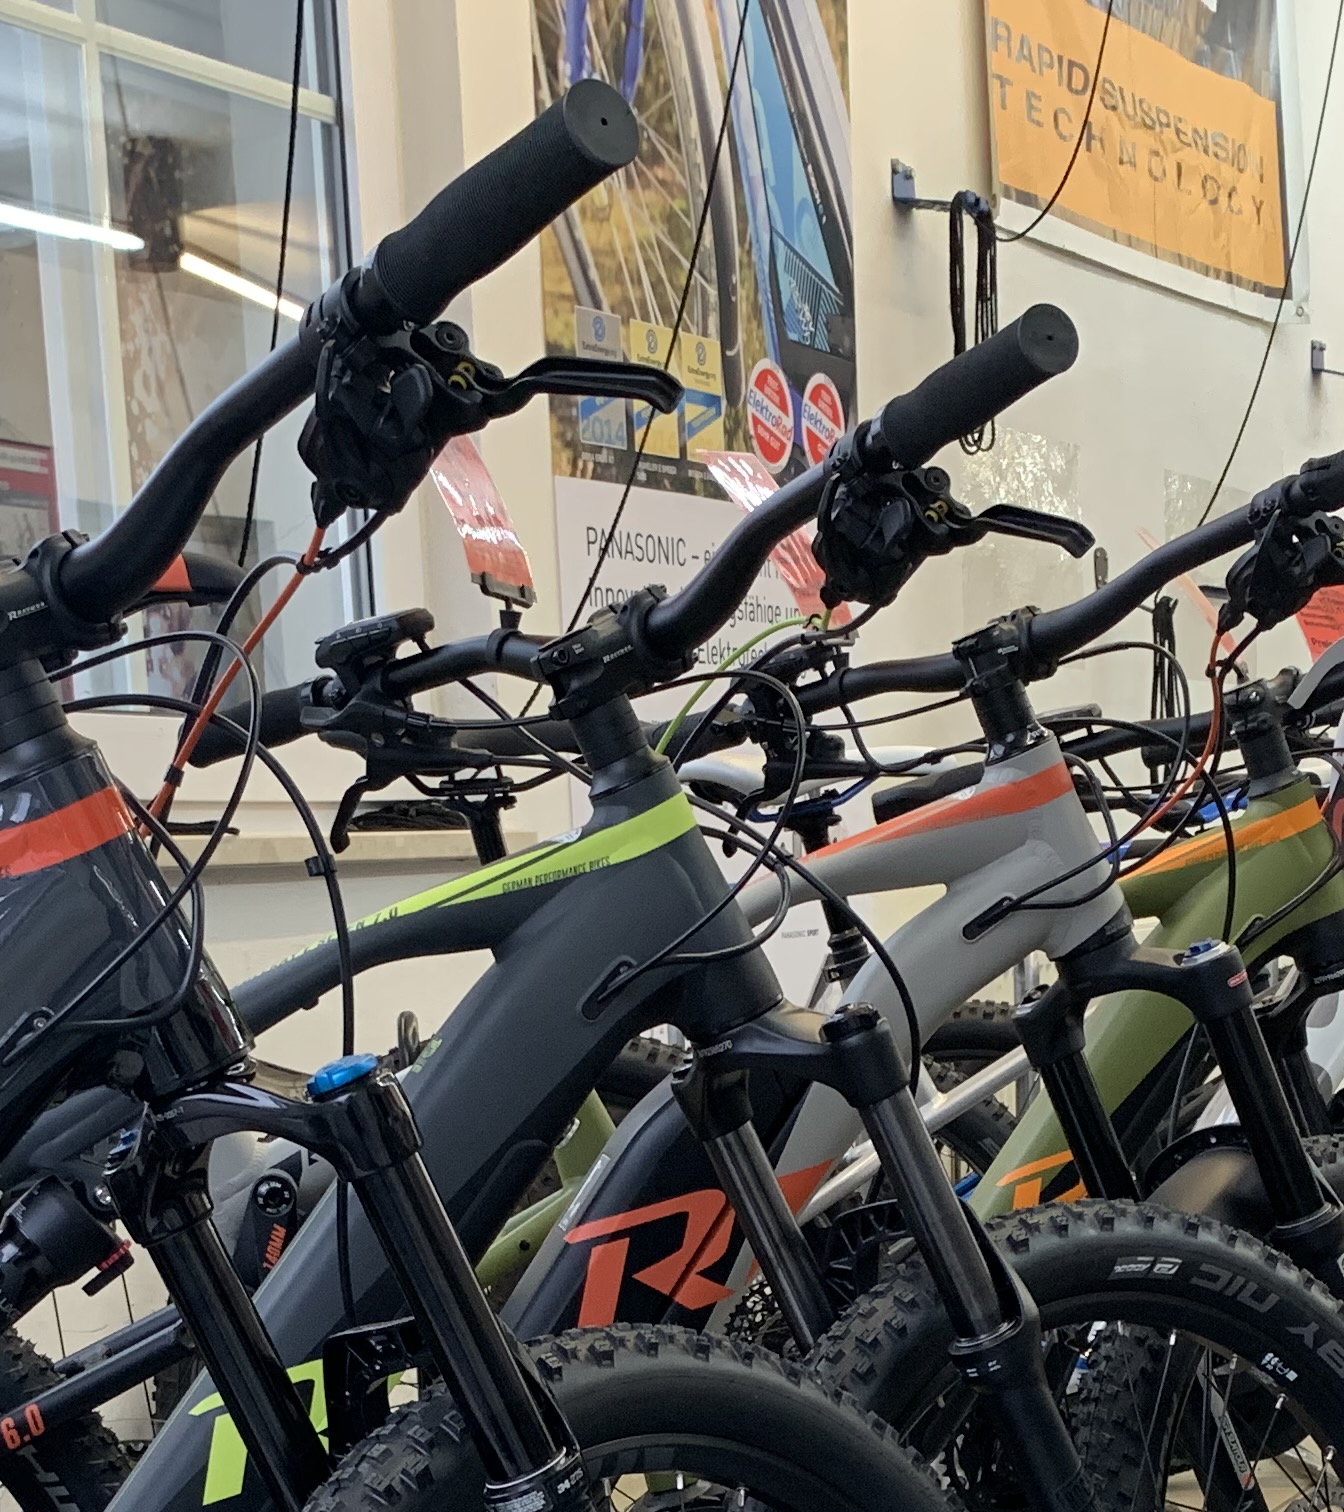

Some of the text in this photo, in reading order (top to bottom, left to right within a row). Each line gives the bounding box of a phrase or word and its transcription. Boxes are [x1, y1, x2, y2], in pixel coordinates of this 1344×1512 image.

[990, 16, 1264, 184] RAPID SUSPENSION
[586, 526, 687, 567] PANASONIC
[1190, 1263, 1280, 1313] NIC
[0, 1403, 46, 1450] 6.0
